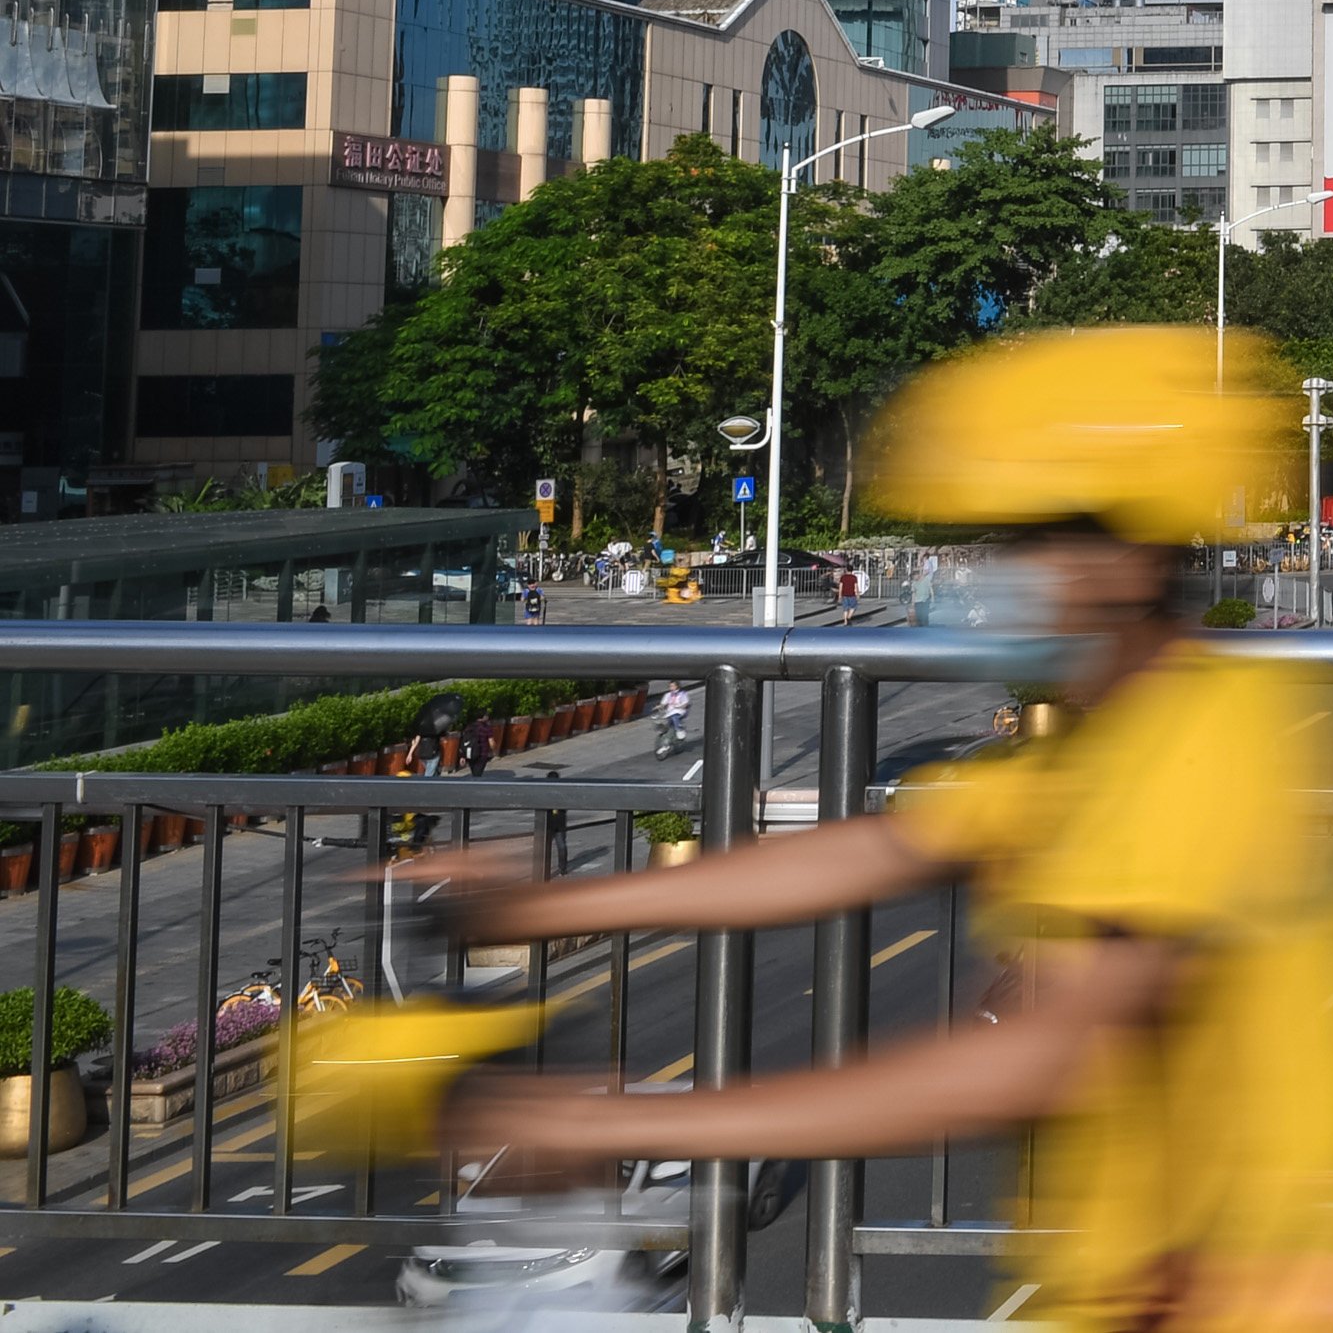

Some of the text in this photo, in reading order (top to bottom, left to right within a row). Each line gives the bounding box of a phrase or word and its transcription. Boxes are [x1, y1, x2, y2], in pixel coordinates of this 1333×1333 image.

[344, 135, 443, 176] 福田公证处
